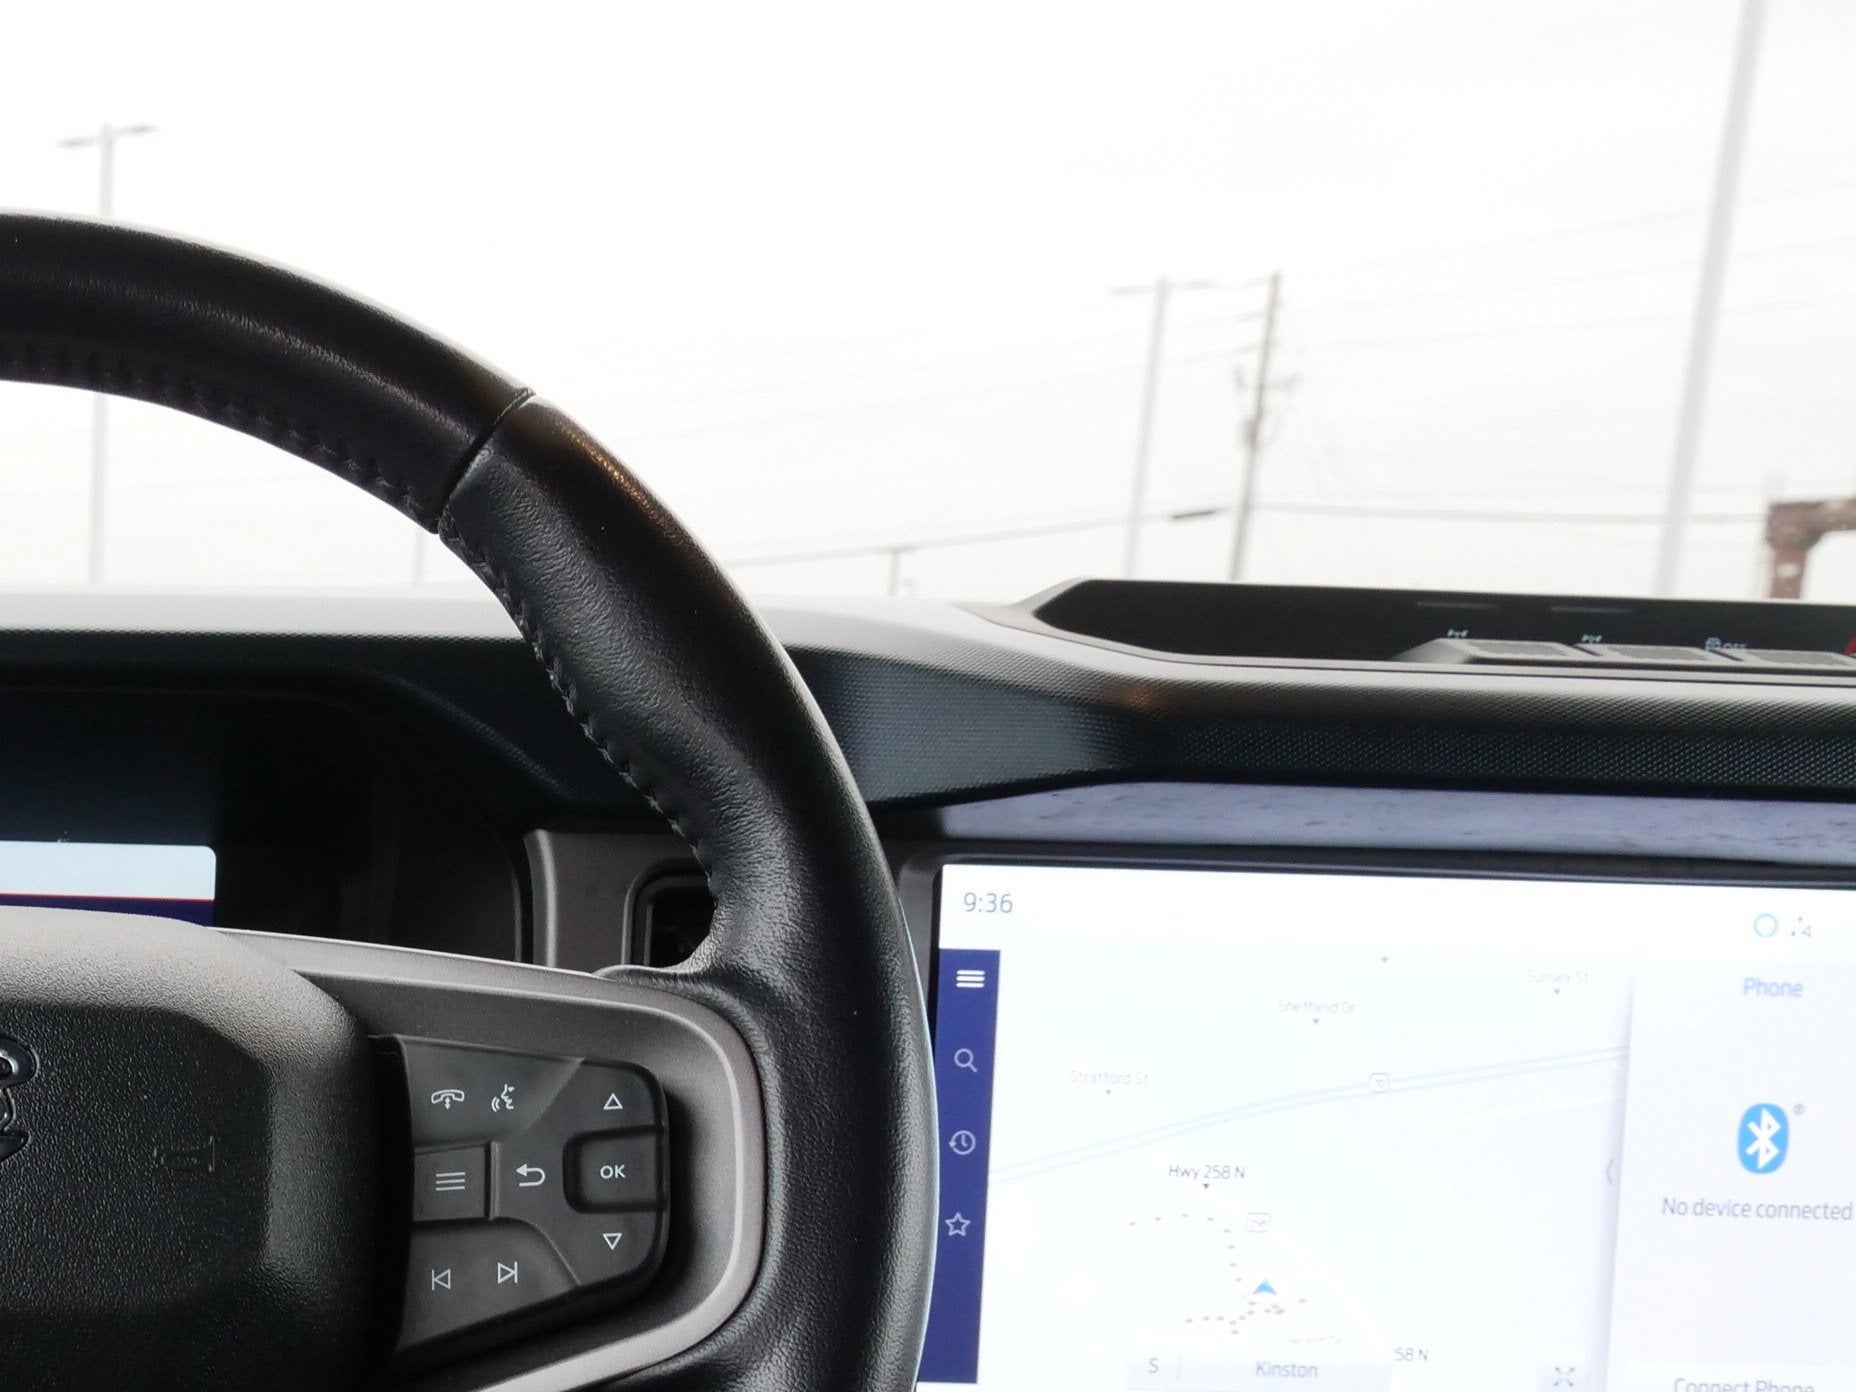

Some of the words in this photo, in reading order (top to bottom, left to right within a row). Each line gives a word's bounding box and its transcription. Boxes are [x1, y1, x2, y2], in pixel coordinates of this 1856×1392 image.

[962, 891, 1014, 914] 9:36
[1742, 976, 1805, 998] Phone
[600, 1164, 626, 1179] OK
[1168, 1164, 1200, 1181] Hwy
[1204, 1164, 1231, 1180] 258
[1234, 1165, 1246, 1180] N
[1661, 1197, 1688, 1216] No
[1692, 1197, 1752, 1218] device
[1755, 1200, 1854, 1221] connected
[1392, 1346, 1415, 1362] 58
[1417, 1347, 1429, 1363] N
[1147, 1357, 1159, 1375] S
[1254, 1359, 1319, 1379] Kinston
